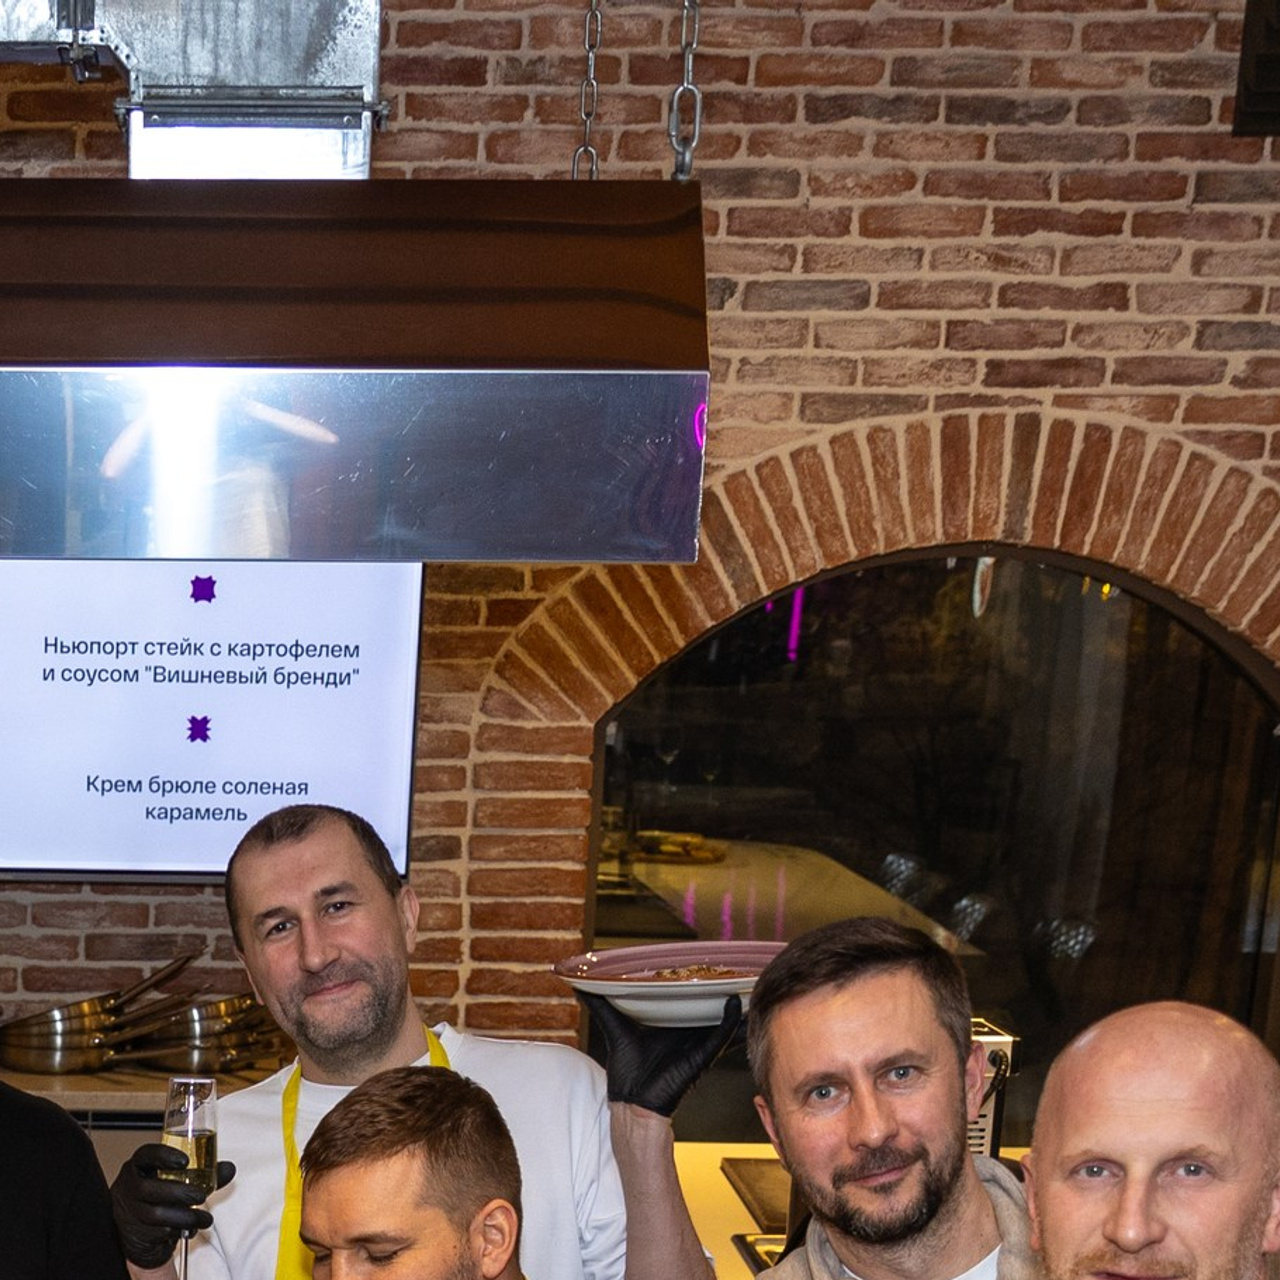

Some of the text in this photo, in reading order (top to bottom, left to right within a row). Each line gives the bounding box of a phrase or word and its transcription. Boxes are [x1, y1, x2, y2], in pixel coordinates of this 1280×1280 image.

[44, 636, 360, 662] Ньюпорт стейк с картофелем
[42, 665, 361, 689] и соусом "Вишневый бренди"
[86, 775, 309, 798] Крем брюле соленая
[145, 806, 248, 825] карамель
